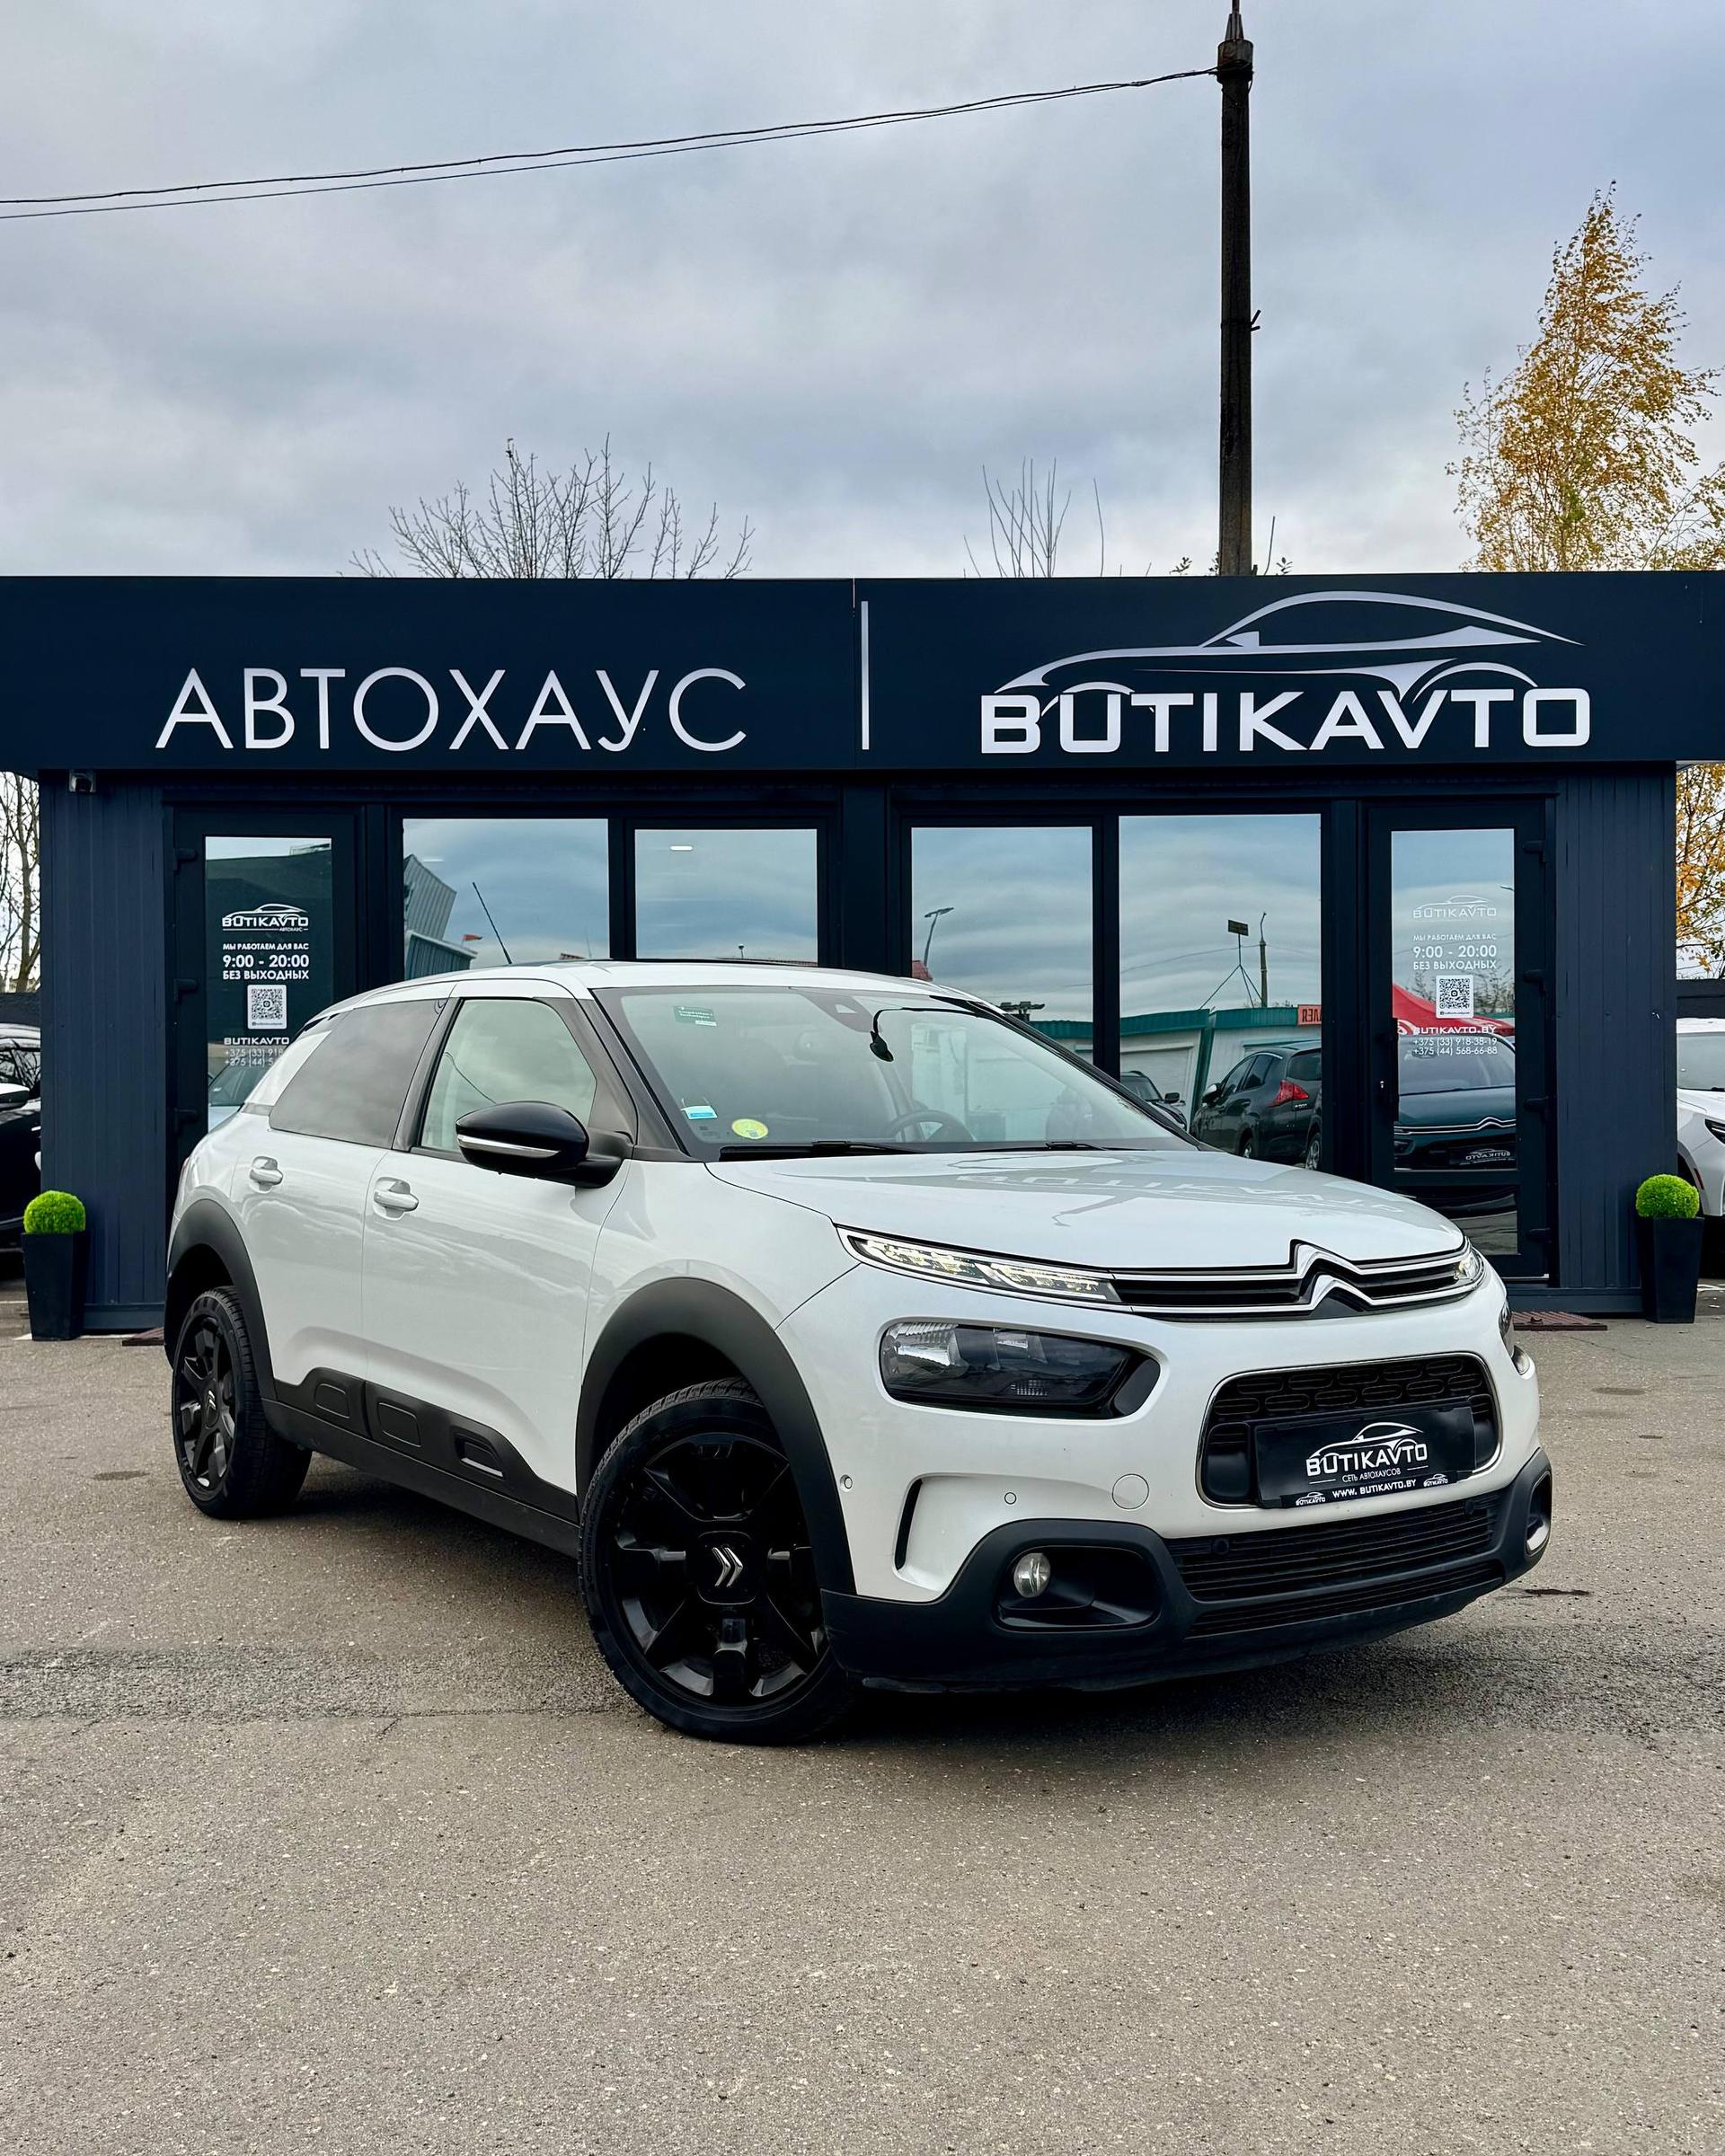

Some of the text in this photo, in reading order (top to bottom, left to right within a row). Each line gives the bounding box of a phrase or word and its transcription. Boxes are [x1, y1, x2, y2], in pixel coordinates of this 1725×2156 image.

[155, 667, 747, 751] АВТОХАУС
[981, 688, 1590, 753] BUTIKAVTO
[1412, 907, 1497, 919] BUTIKAVTO
[222, 916, 309, 927] BUTIKAVTO
[222, 942, 309, 950] МЫ РАБОТАЕМ ДЛЯ ВАС
[1413, 946, 1443, 959] 9:00
[1458, 945, 1497, 958] 20:00
[223, 954, 254, 968] 9:00
[269, 954, 310, 968] 20:00
[1413, 960, 1497, 970] БЕЗ ВЫХОДНЫХ
[223, 970, 309, 980] БЕЗ ВЫХОДНЫХ
[1413, 1025, 1498, 1034] BUTIKAVTO.BY
[1413, 1037, 1498, 1047] +375 (33) 918-38-19
[225, 1048, 246, 1057] +375
[249, 1048, 265, 1059] (33)
[1413, 1046, 1498, 1056] +375 (44) 568-66-88
[249, 1057, 265, 1067] (44)
[1305, 1444, 1428, 1477] BUTIKAVTO
[1342, 1468, 1402, 1482] СЕТЬ АВТОХАУСОВ
[1332, 1480, 1416, 1498] WWW. BUTIKAVTO.BY
